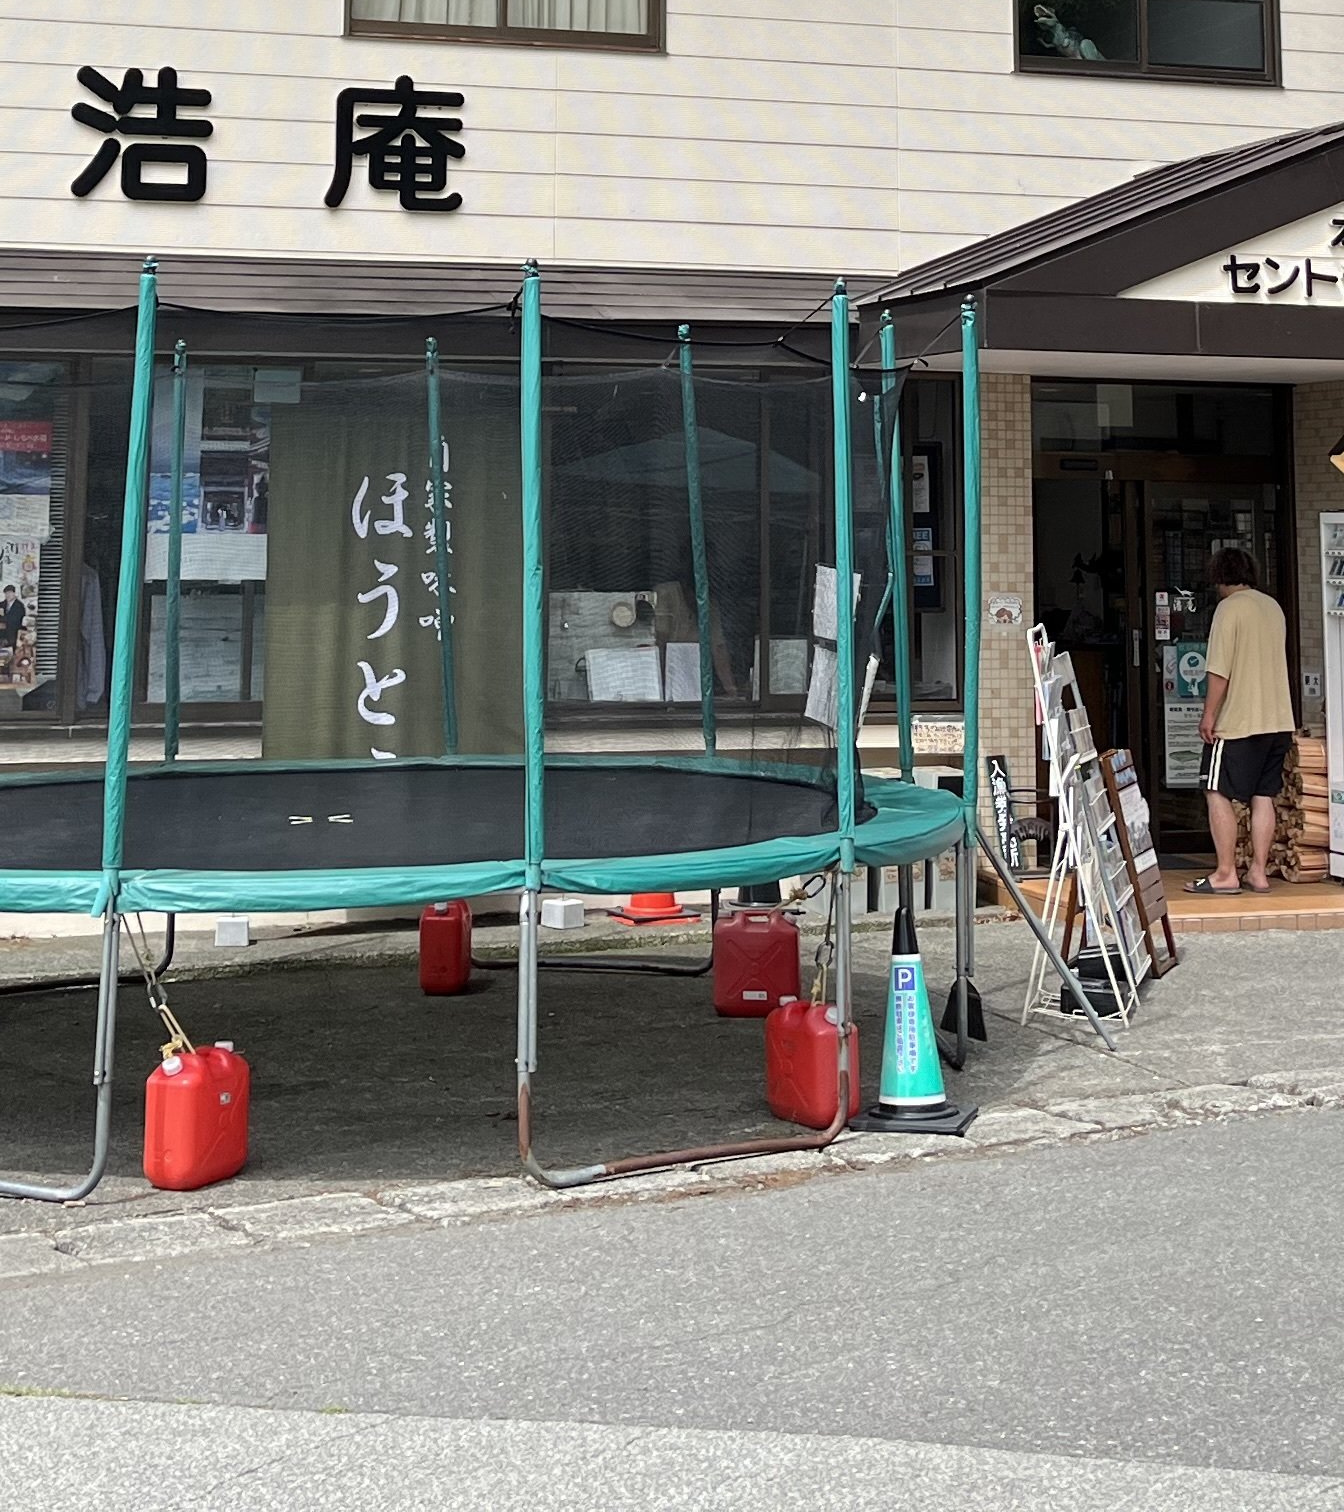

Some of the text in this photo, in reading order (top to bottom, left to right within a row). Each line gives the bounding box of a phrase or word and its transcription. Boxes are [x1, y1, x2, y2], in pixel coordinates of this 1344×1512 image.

[351, 472, 413, 759] ほうと
[898, 969, 913, 989] P
